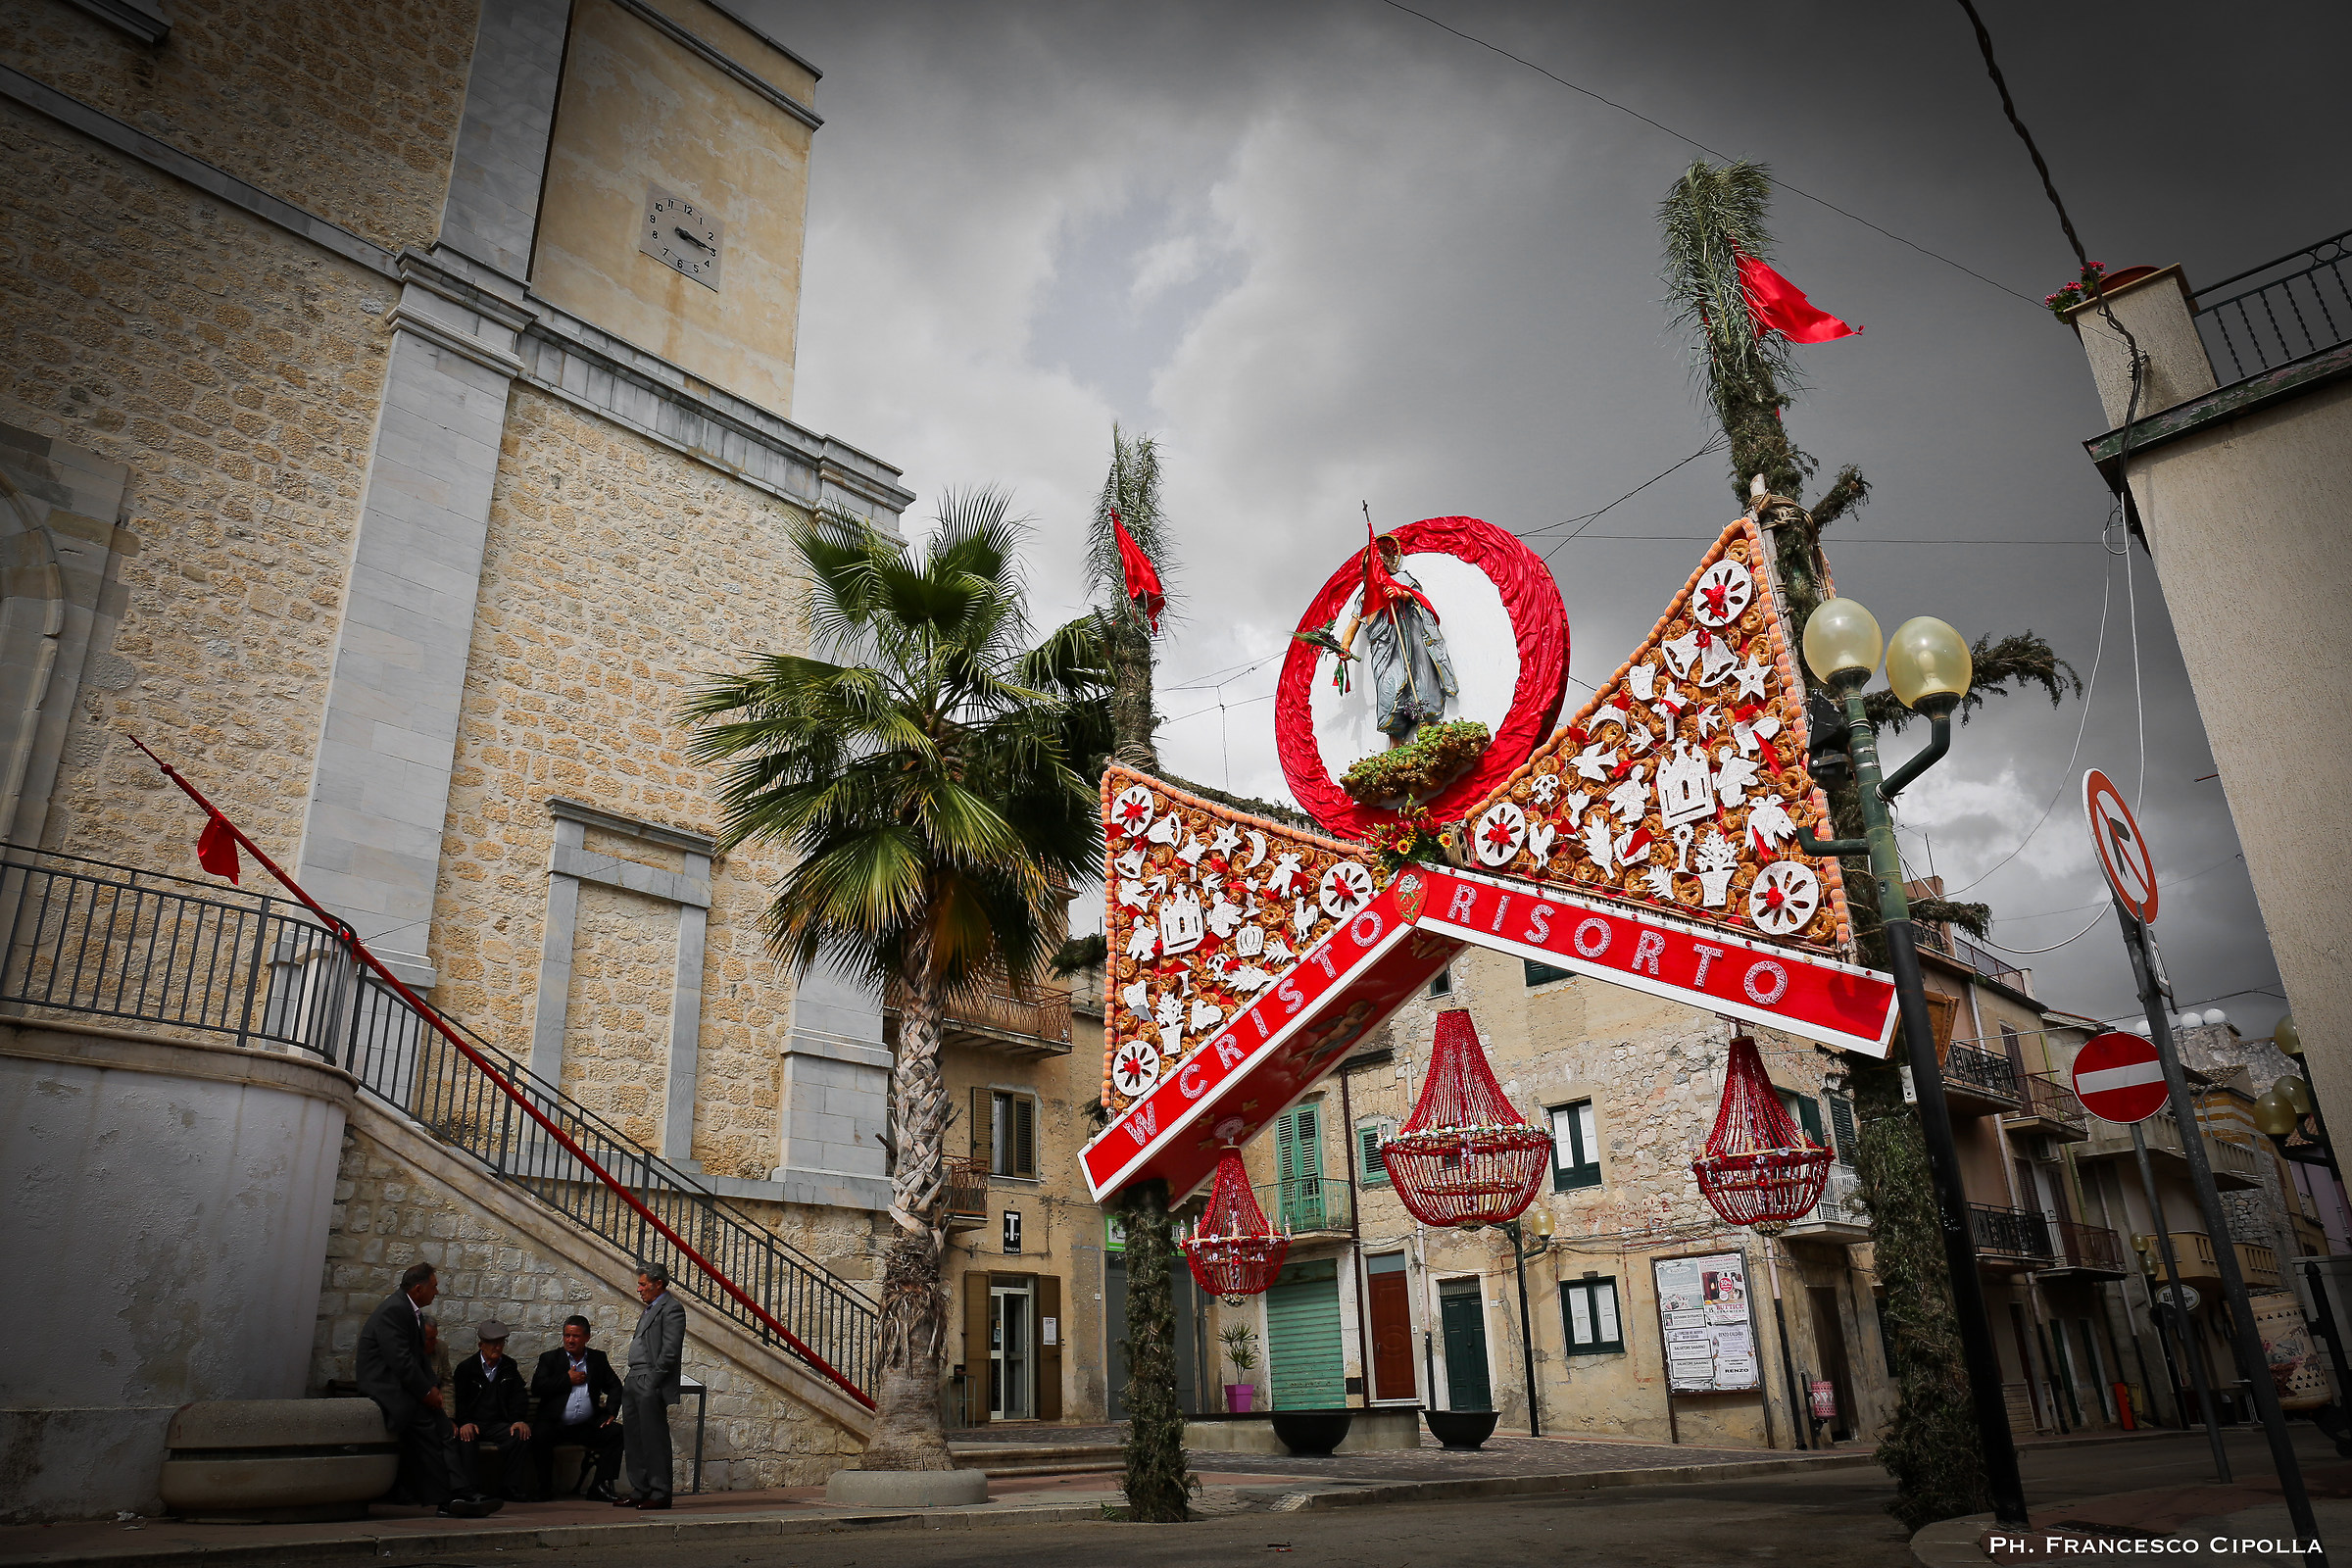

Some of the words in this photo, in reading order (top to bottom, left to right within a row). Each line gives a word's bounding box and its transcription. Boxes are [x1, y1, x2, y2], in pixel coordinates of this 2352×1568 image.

[655, 202, 663, 213] 10
[667, 199, 674, 209] 11
[684, 204, 693, 216] 12
[649, 215, 657, 223] 9
[652, 230, 659, 239] 8
[708, 231, 714, 241] 2
[662, 247, 669, 257] 7
[710, 248, 716, 258] 3
[677, 260, 683, 269] 6
[693, 264, 700, 273] 5
[704, 260, 710, 269] 4
[1446, 882, 1788, 1005] RISORTO
[1122, 1101, 1157, 1148] W
[1178, 909, 1384, 1101] CRISTO
[1005, 1213, 1019, 1242] T
